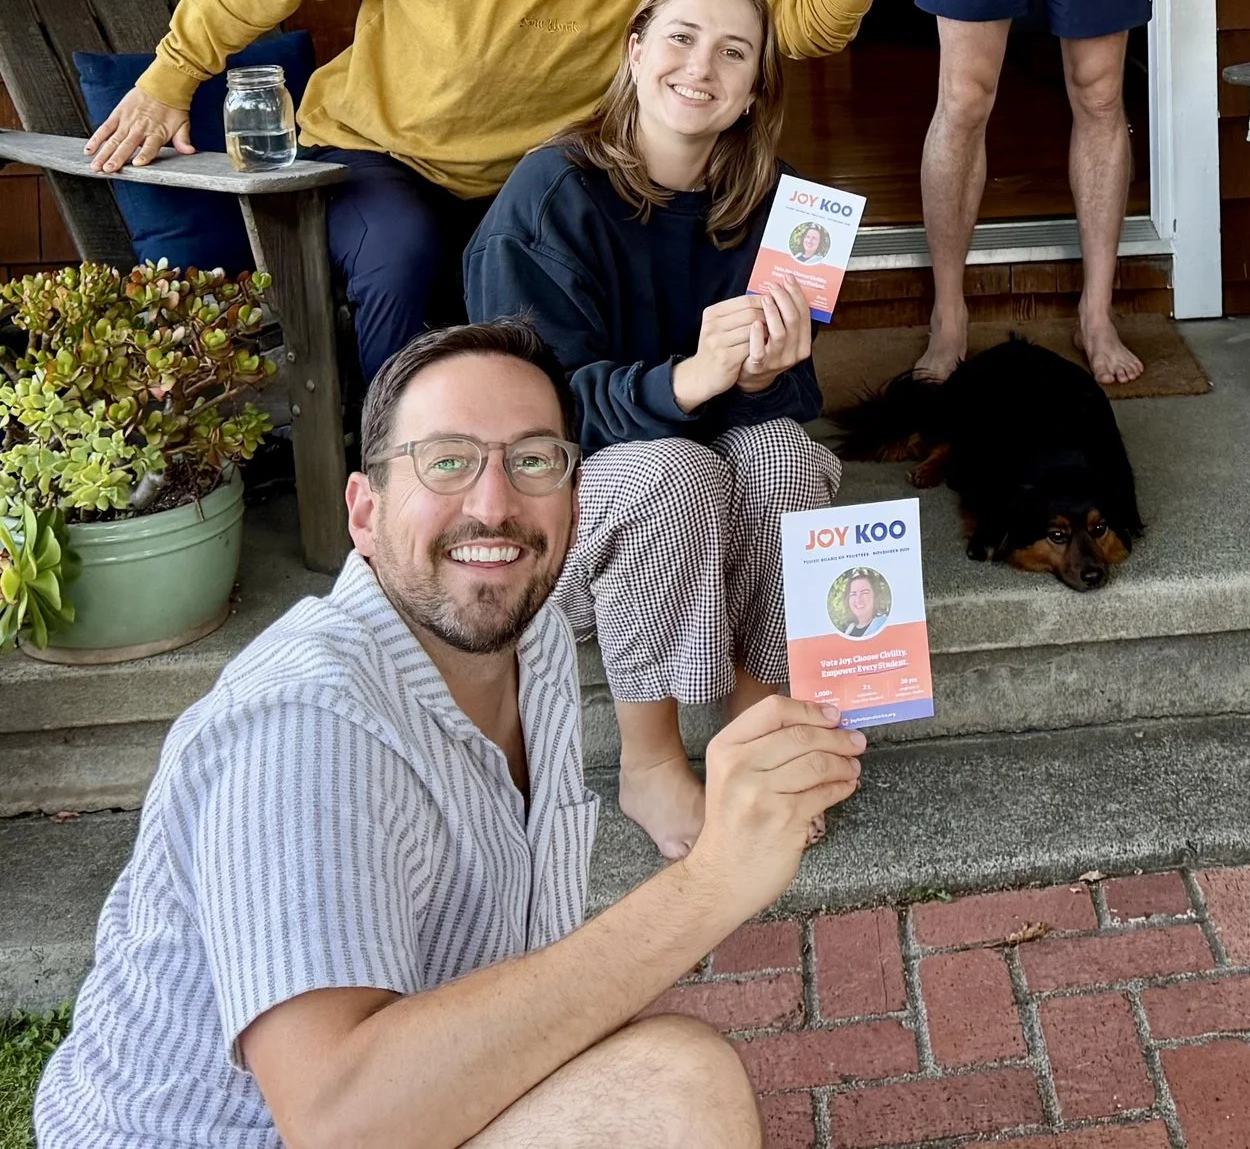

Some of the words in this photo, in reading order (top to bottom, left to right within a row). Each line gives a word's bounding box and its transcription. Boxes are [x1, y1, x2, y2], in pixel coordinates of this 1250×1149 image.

[789, 190, 818, 208] JOY
[820, 198, 852, 217] KOO
[805, 526, 849, 550] JOY
[855, 520, 906, 544] KOO
[853, 654, 879, 662] Choose
[880, 649, 907, 659] Civility.
[821, 667, 856, 678] Empower
[857, 664, 877, 674] Every
[879, 659, 908, 668] Student.
